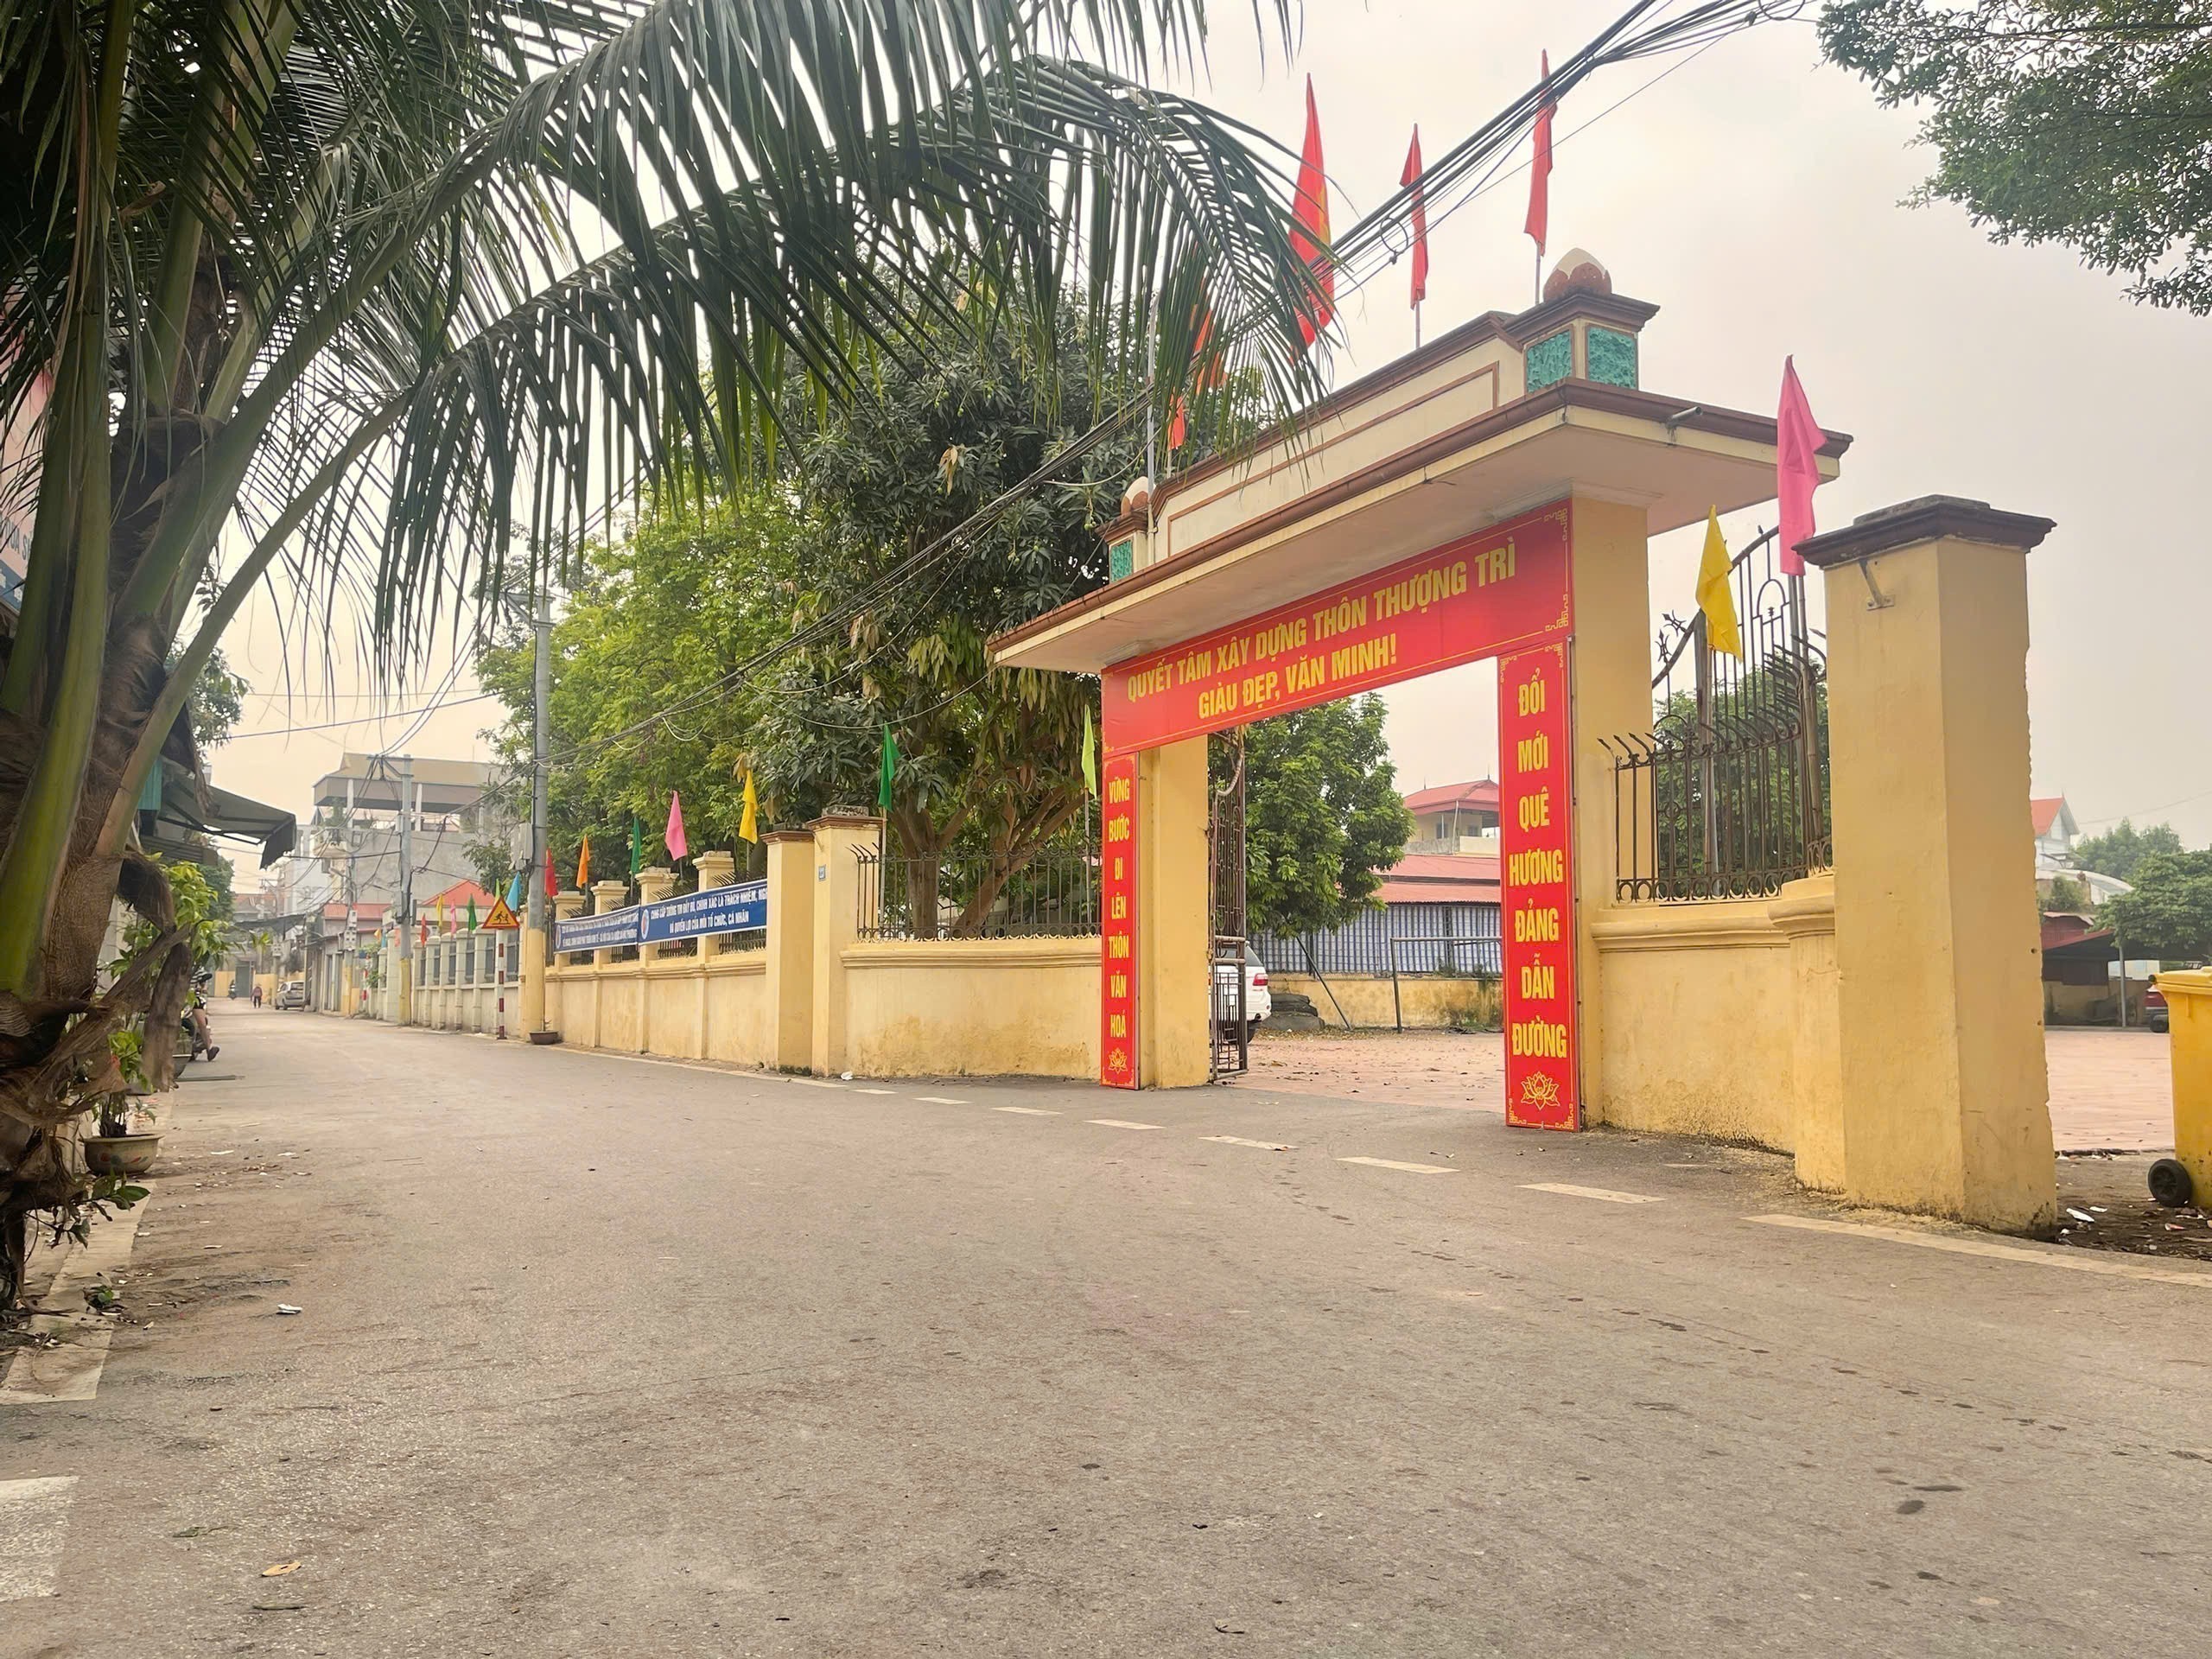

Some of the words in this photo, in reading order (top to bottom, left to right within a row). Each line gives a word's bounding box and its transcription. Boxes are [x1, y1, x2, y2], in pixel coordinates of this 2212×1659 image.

[1128, 657, 1173, 702] QUYẾT
[1177, 651, 1211, 685] TÂM
[1217, 636, 1250, 673] XÂY
[1255, 618, 1306, 662] DỰNG
[1313, 596, 1367, 641] THÔN
[1374, 562, 1467, 621] THƯỢNG
[1474, 537, 1516, 588] TRÌ
[1198, 682, 1237, 719] GIÀU
[1243, 671, 1281, 709] ĐẸP,
[1285, 655, 1325, 694] VĂN
[1331, 633, 1396, 681] MINH!
[1518, 667, 1545, 716] ĐỔI
[1517, 730, 1548, 773] MỚI
[1109, 777, 1129, 804] VỮNG
[1518, 786, 1550, 832] QUÊ
[1109, 813, 1129, 842] BƯỚC
[1115, 857, 1123, 880] ĐI
[1509, 849, 1563, 887] HƯƠNG
[1111, 892, 1126, 919] LÊN
[1515, 898, 1559, 943] ĐẢNG
[1109, 931, 1129, 958] THÔN
[1110, 970, 1127, 998] VĂN
[1521, 953, 1554, 1000] DẪN
[1110, 1010, 1127, 1038] HOÁ
[1512, 1014, 1567, 1058] ĐƯỜNG
